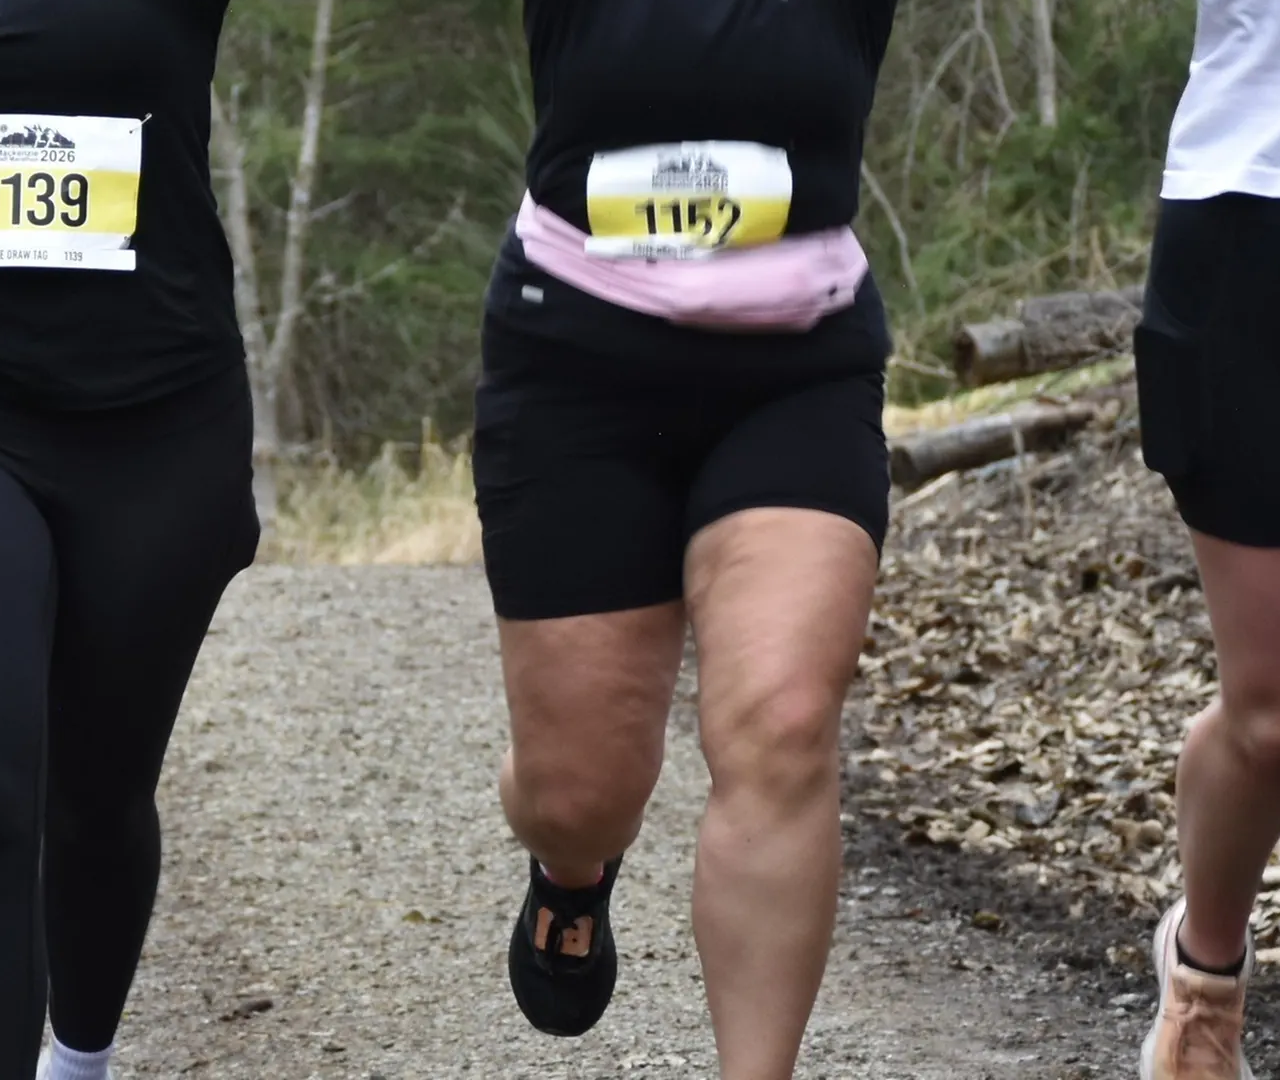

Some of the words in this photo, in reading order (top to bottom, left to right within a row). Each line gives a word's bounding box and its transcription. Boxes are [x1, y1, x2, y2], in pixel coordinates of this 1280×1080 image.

[40, 149, 75, 162] 2026
[635, 197, 741, 248] 1152
[33, 250, 48, 261] TAG
[64, 251, 83, 261] 1139
